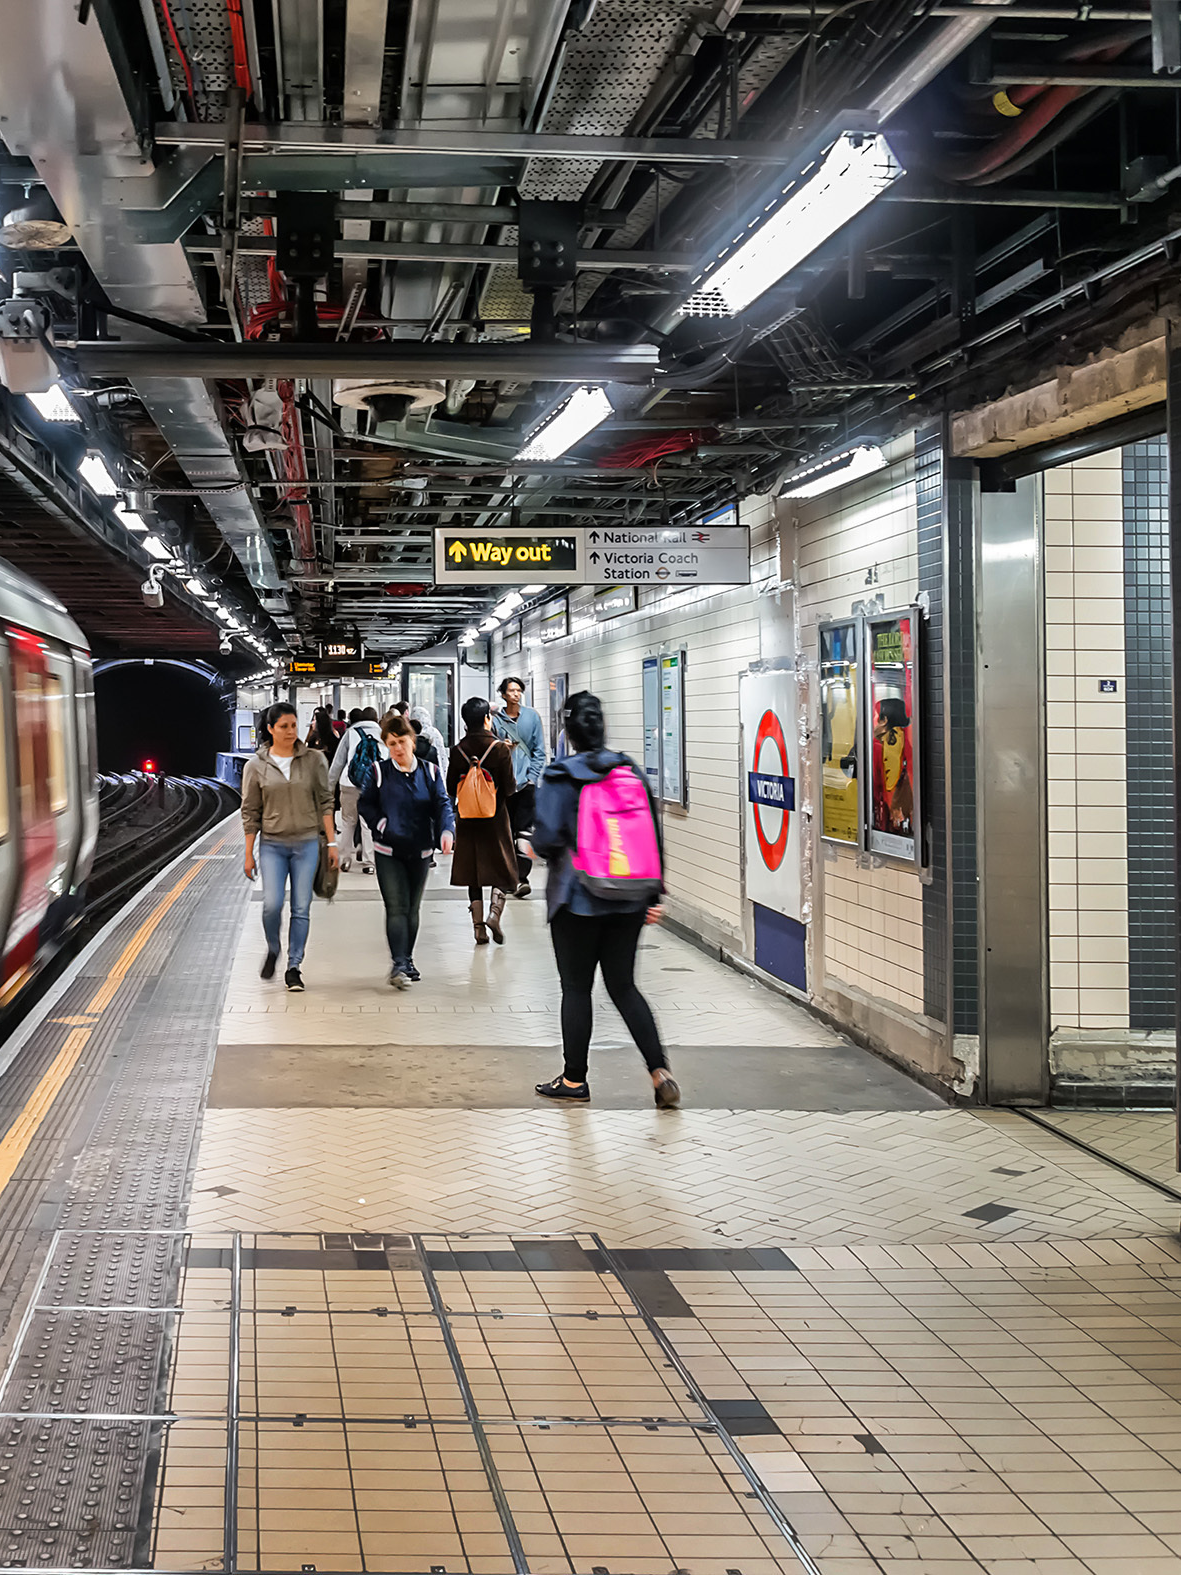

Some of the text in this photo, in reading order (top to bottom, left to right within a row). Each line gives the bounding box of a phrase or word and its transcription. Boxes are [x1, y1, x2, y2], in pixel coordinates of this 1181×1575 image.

[604, 531, 658, 544] National
[469, 542, 552, 566] Way out
[604, 552, 699, 565] Victoria Coach
[604, 567, 650, 580] Station
[756, 779, 785, 802] VICTORIA
